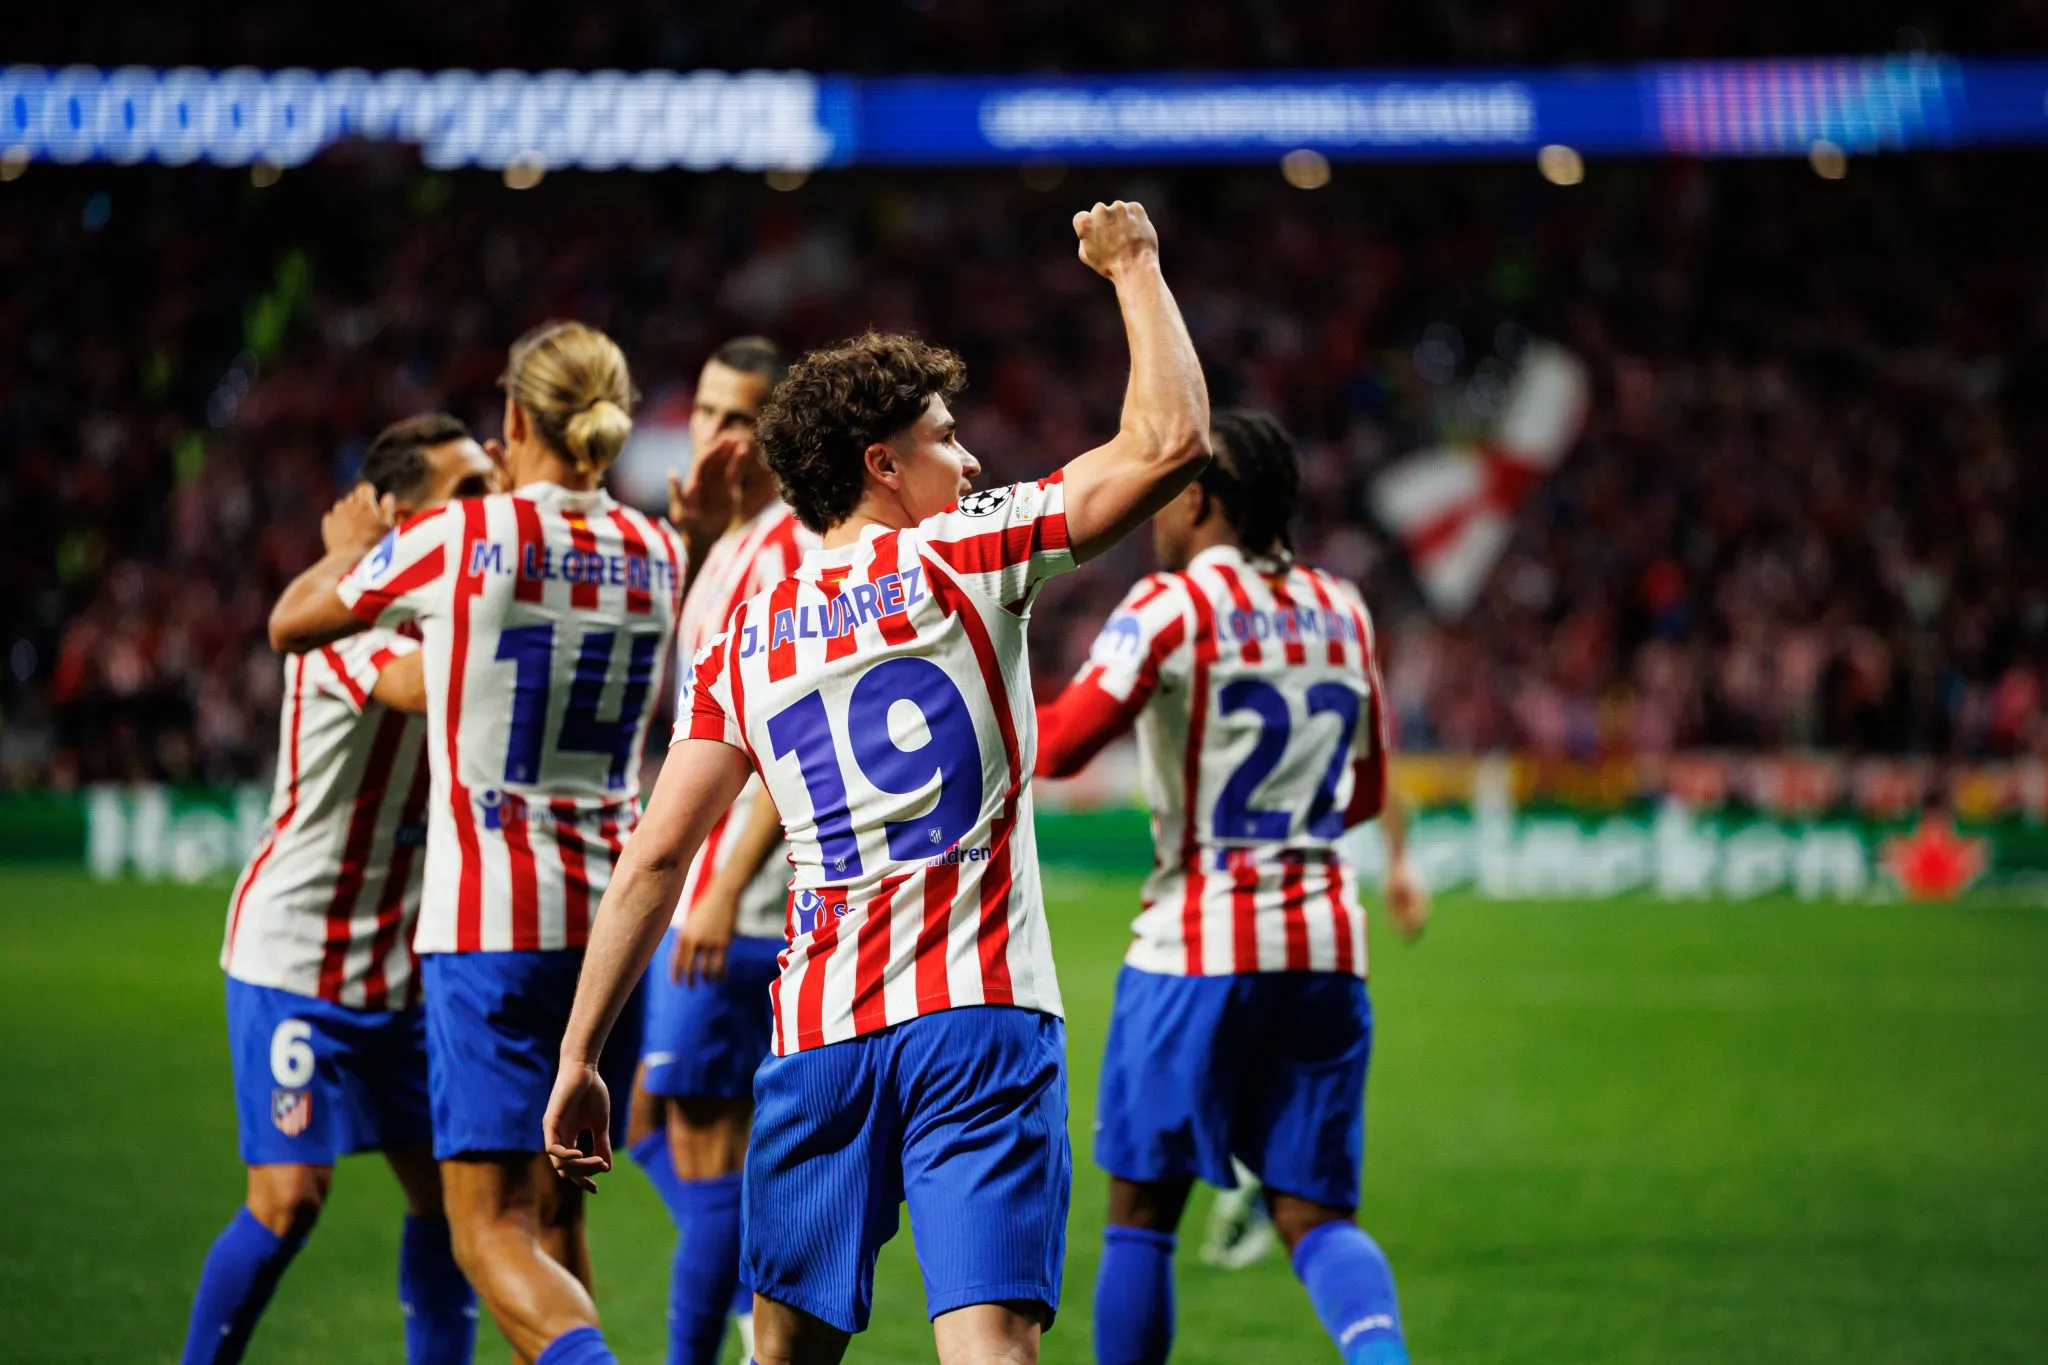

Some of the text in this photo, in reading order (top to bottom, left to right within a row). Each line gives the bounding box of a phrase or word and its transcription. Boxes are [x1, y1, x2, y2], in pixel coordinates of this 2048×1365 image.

[468, 538, 513, 577] M.
[740, 565, 925, 659] J. ALVAREZ
[495, 622, 661, 791] 14
[766, 656, 984, 882] 19
[1212, 676, 1361, 841] 22
[269, 1018, 316, 1089] 6
